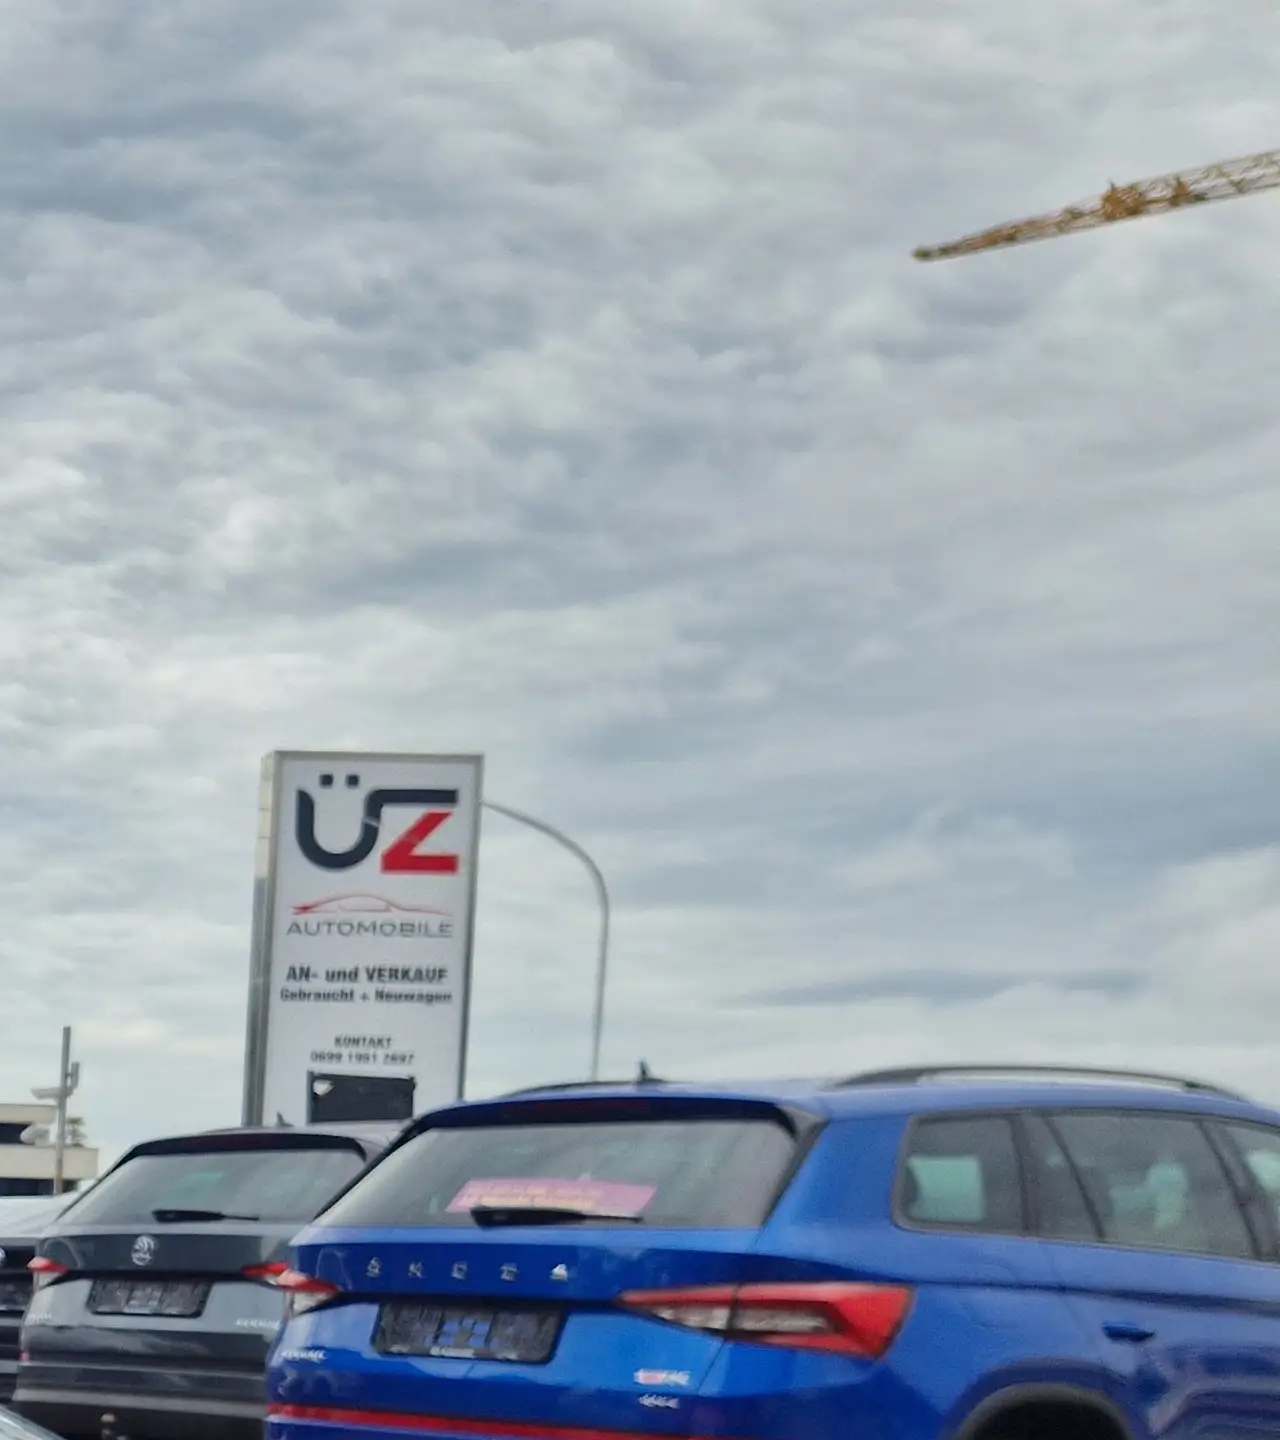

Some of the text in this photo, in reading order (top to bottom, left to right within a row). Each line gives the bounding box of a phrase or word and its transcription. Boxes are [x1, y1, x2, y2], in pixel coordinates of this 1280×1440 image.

[286, 919, 454, 939] AUTOMOBILE
[286, 965, 448, 983] AN- und VERKAUF
[334, 1034, 393, 1048] KONTAKT
